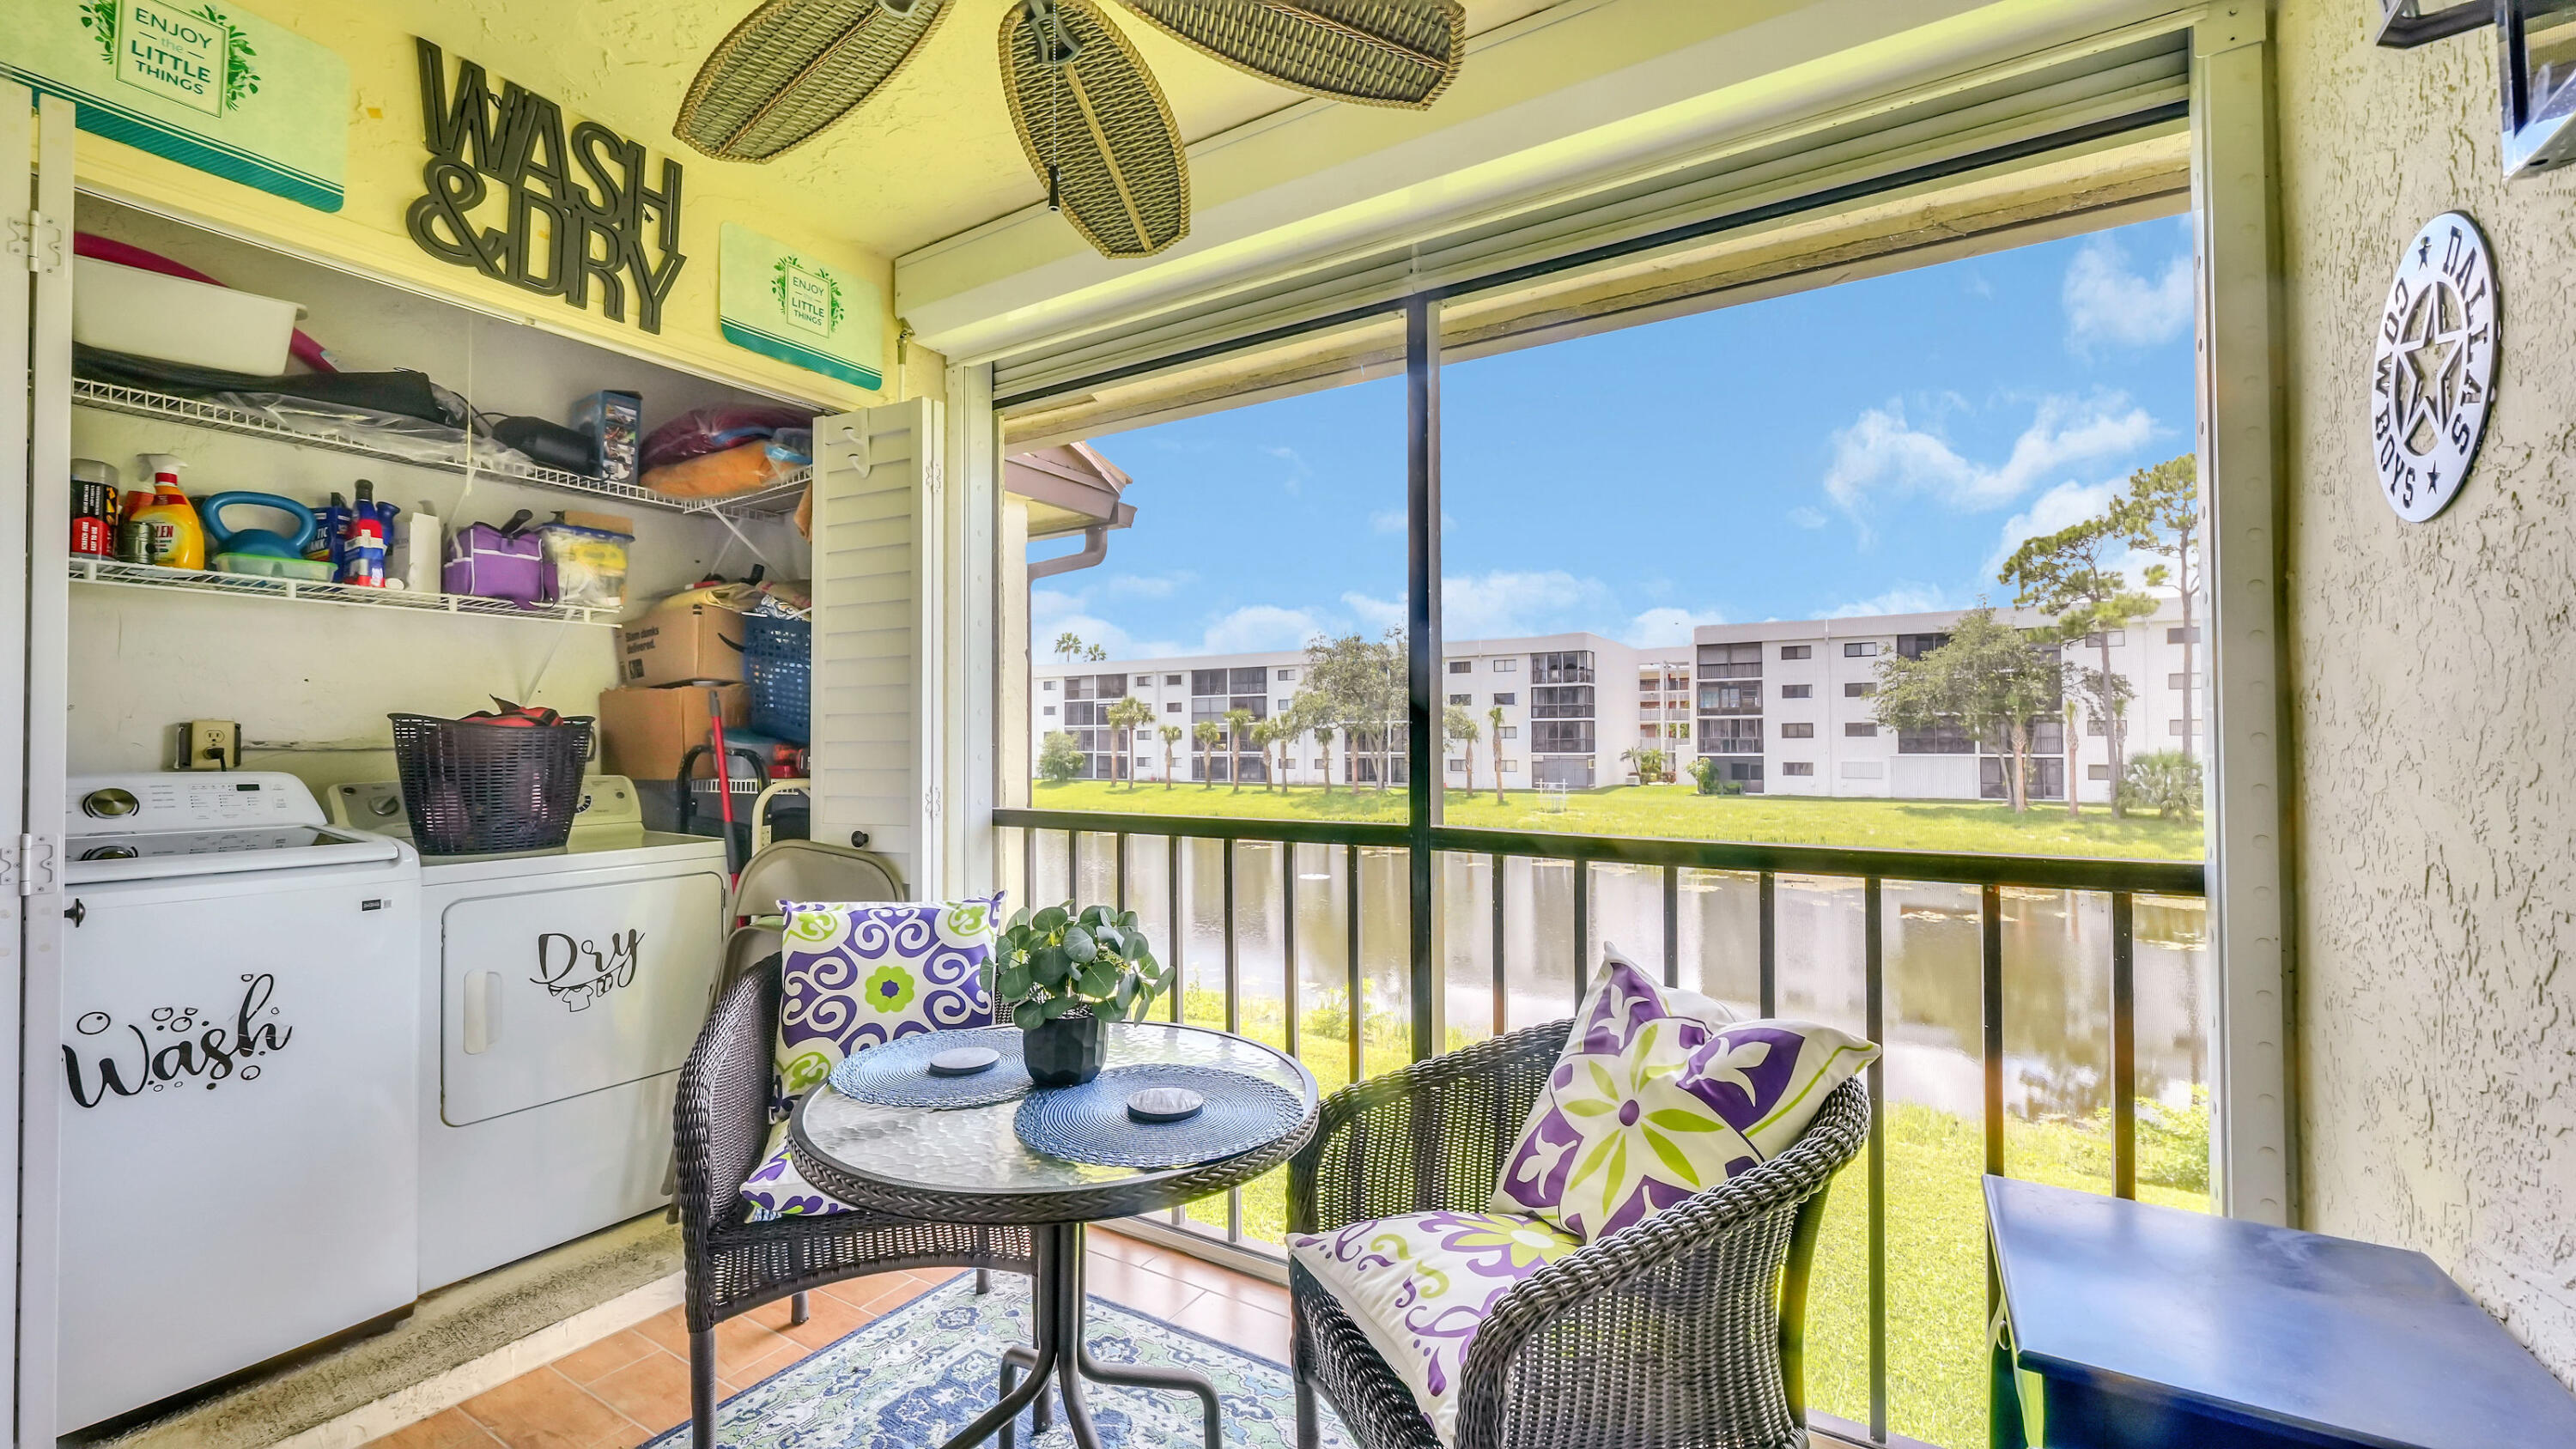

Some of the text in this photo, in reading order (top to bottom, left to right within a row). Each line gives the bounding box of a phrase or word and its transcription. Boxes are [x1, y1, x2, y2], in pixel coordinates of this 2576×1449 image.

[136, 8, 212, 48] ENJOY
[161, 38, 183, 52] the
[131, 39, 210, 83] LITTLE
[136, 60, 204, 94] THINGS
[417, 37, 683, 255] WASH
[406, 155, 687, 335] & DRY
[792, 297, 824, 318] LITTLE
[793, 276, 824, 296] ENJOY
[793, 309, 822, 325] THINGS
[2443, 225, 2488, 456] DALLAS
[2375, 277, 2415, 508] COWBOYS
[530, 929, 645, 987] Dry
[63, 973, 292, 1108] Wash
